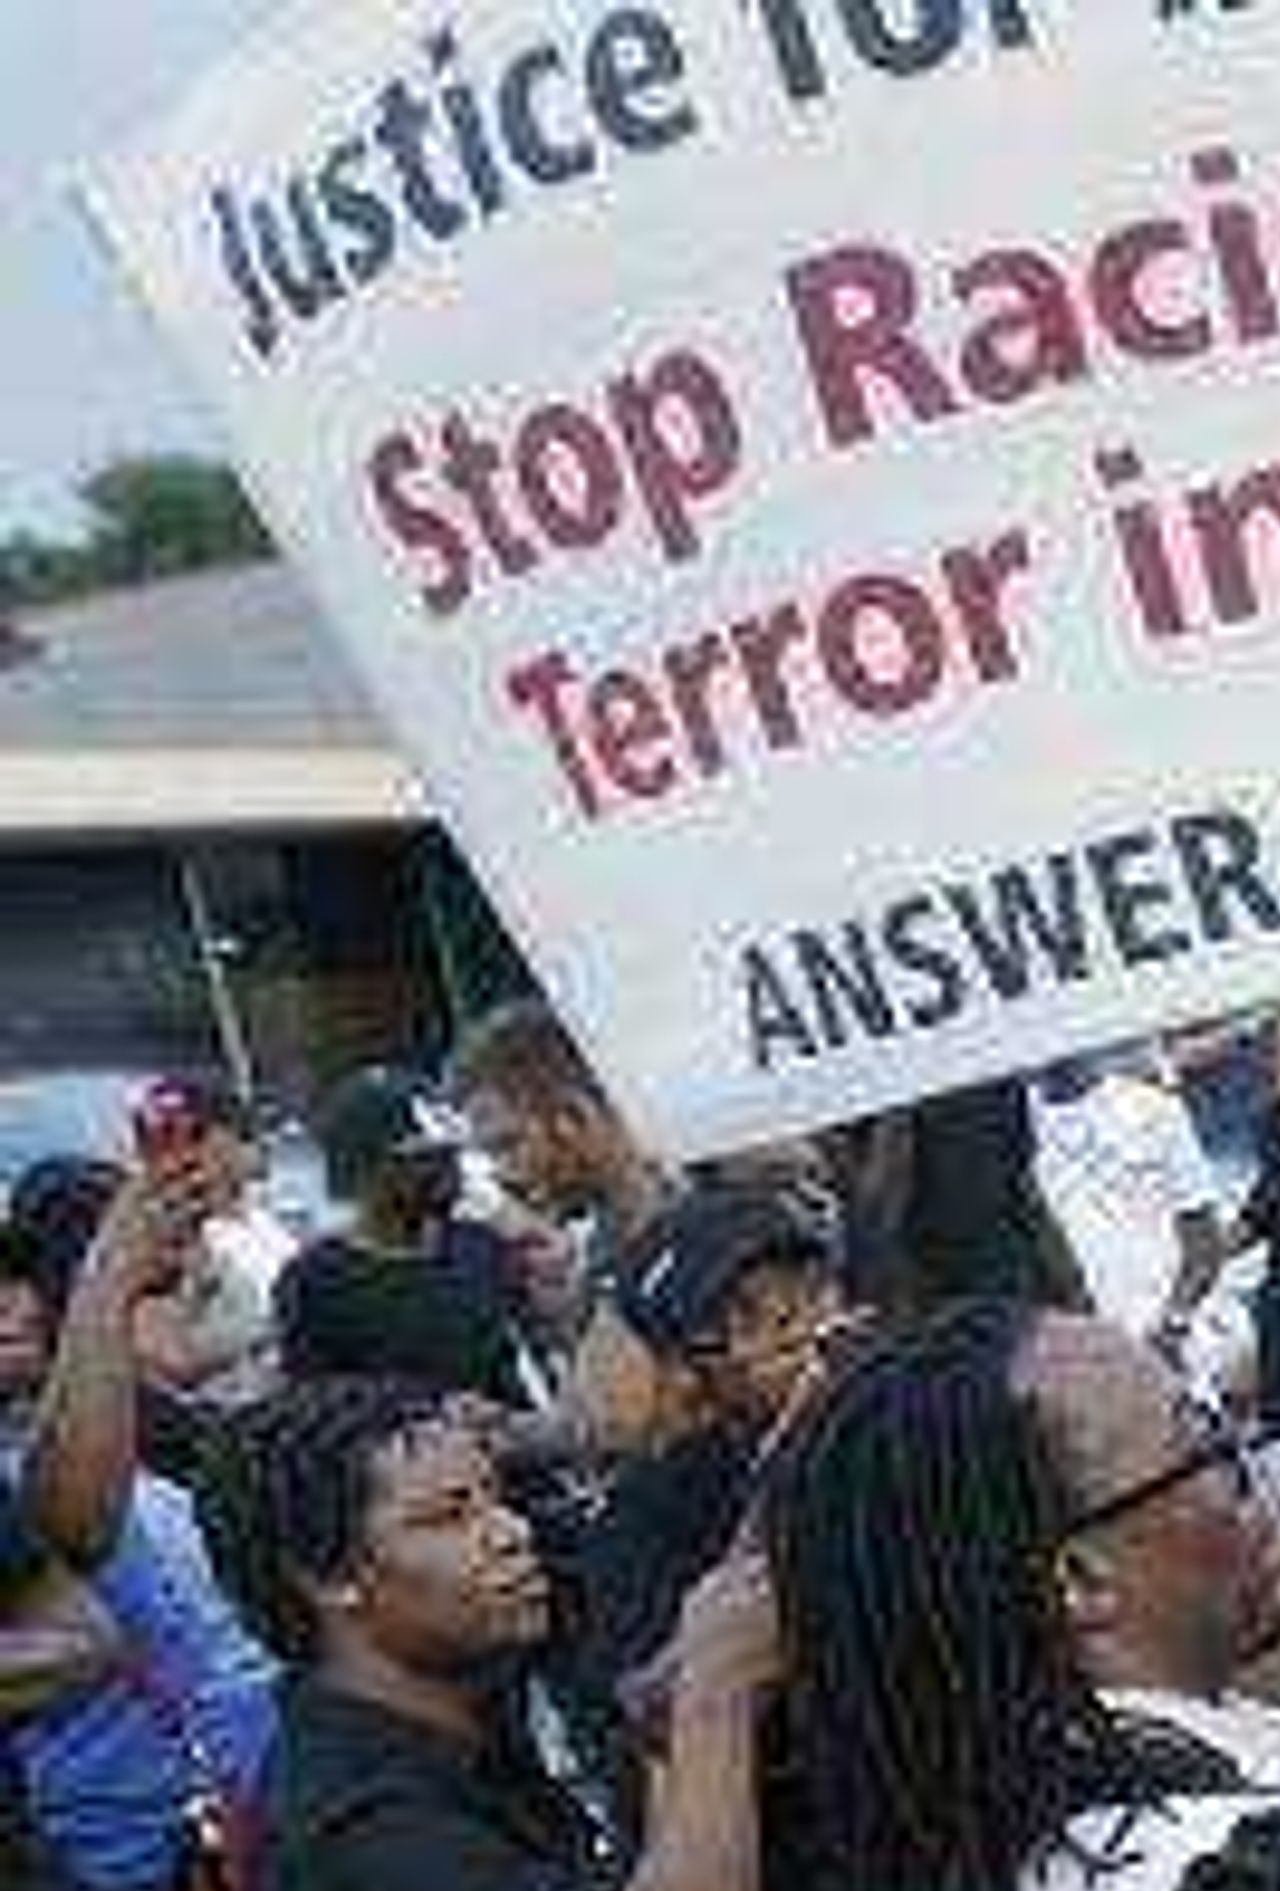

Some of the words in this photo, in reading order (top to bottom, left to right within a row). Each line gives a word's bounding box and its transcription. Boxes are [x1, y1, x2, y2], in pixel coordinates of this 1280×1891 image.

[206, 8, 697, 357] Justice
[364, 348, 742, 615] Stop
[506, 531, 1030, 820] Terror
